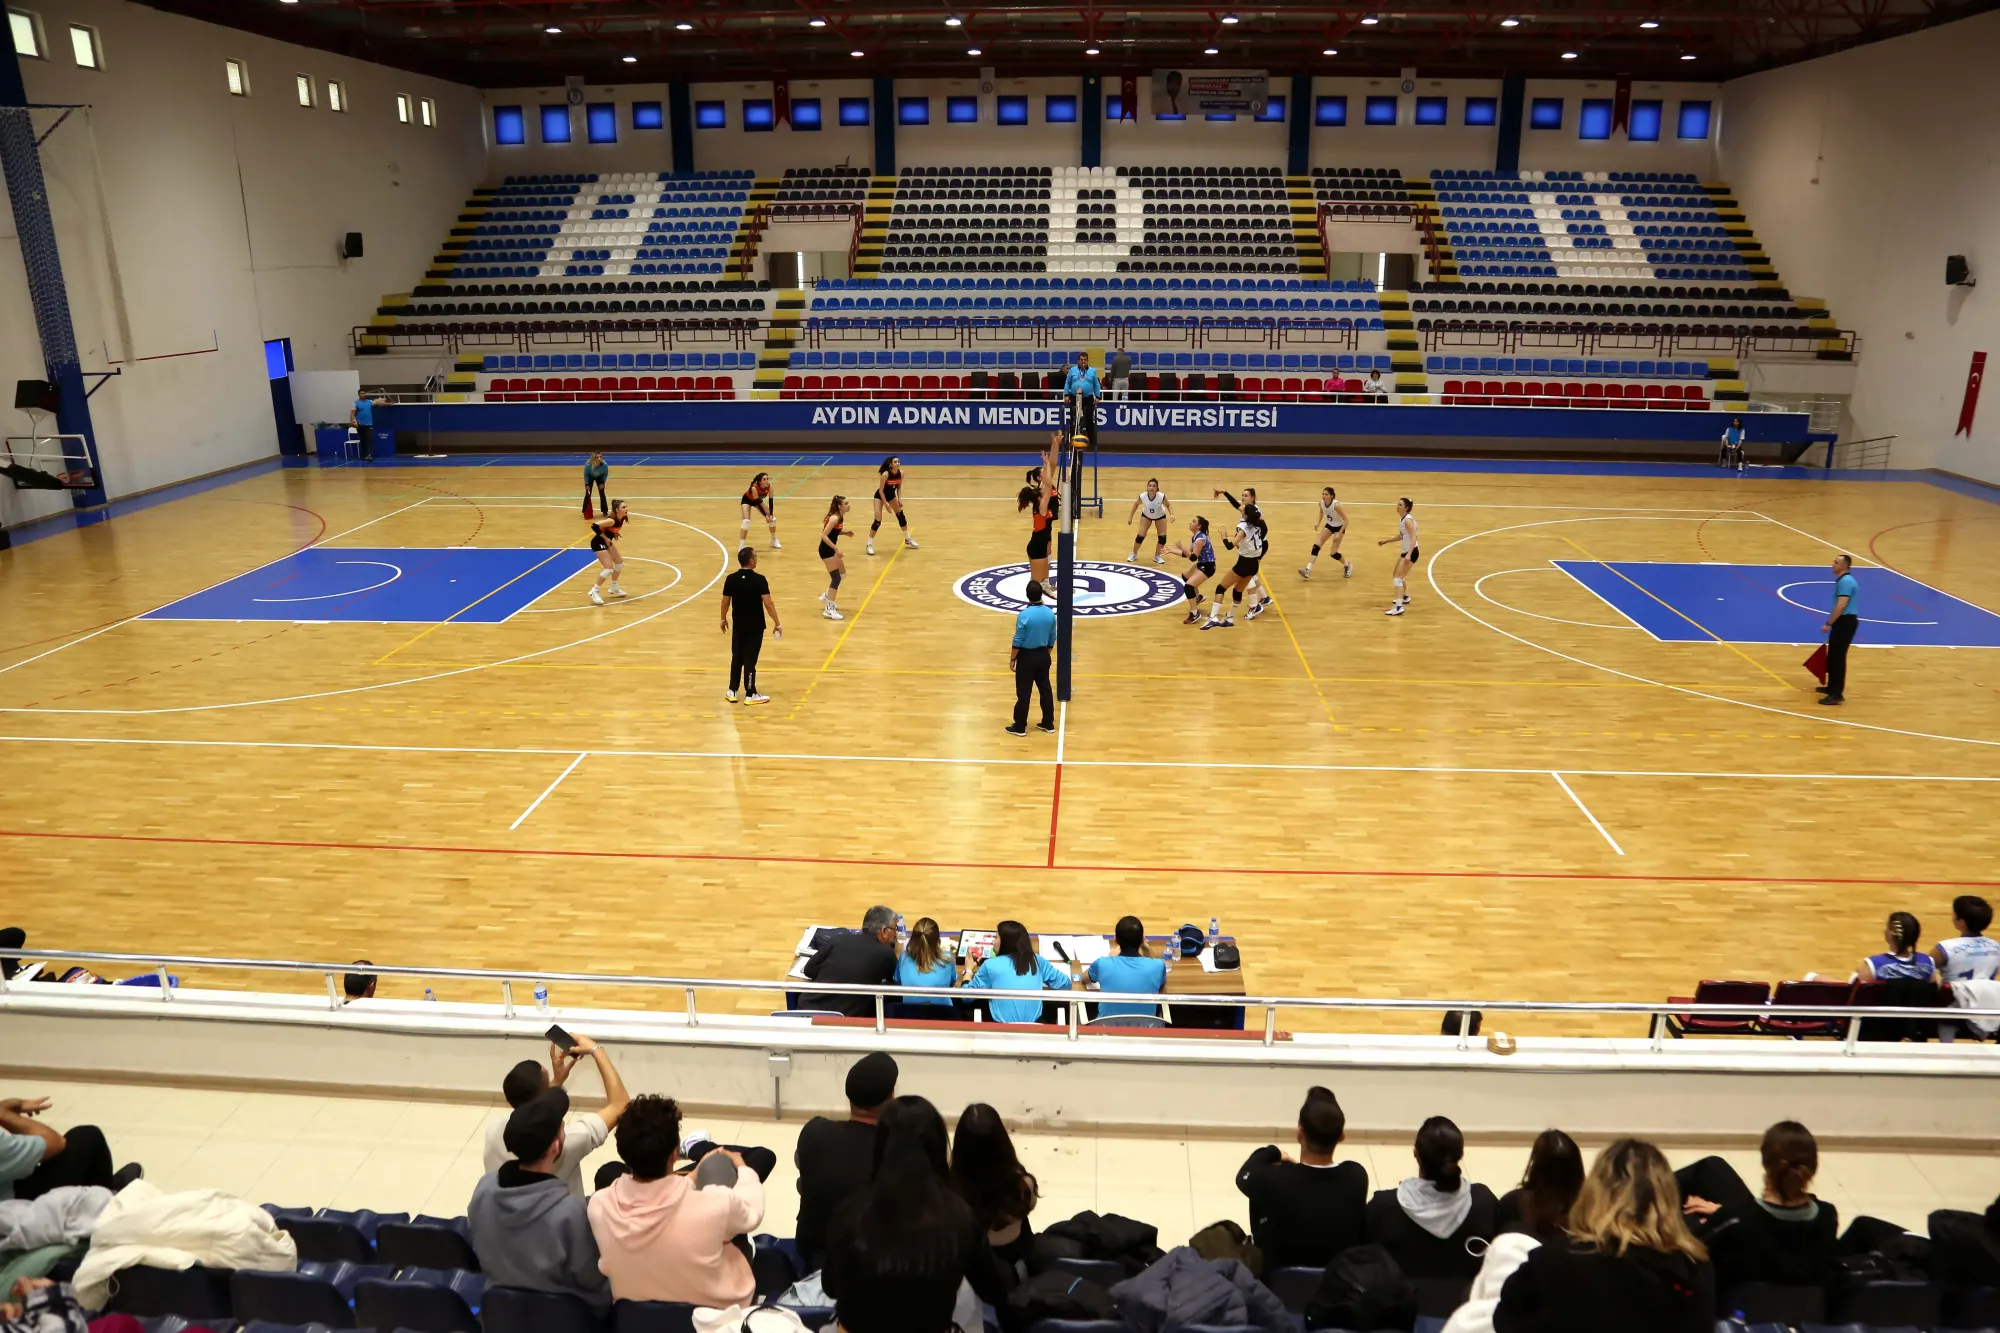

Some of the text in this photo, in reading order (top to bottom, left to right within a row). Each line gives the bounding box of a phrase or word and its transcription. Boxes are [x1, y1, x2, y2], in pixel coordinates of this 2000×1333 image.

[812, 407, 880, 425] AYDIN
[887, 407, 970, 425] ADNAN
[1115, 405, 1278, 427] ÜNİVERSİTESİ
[1148, 580, 1177, 601] AYDIN
